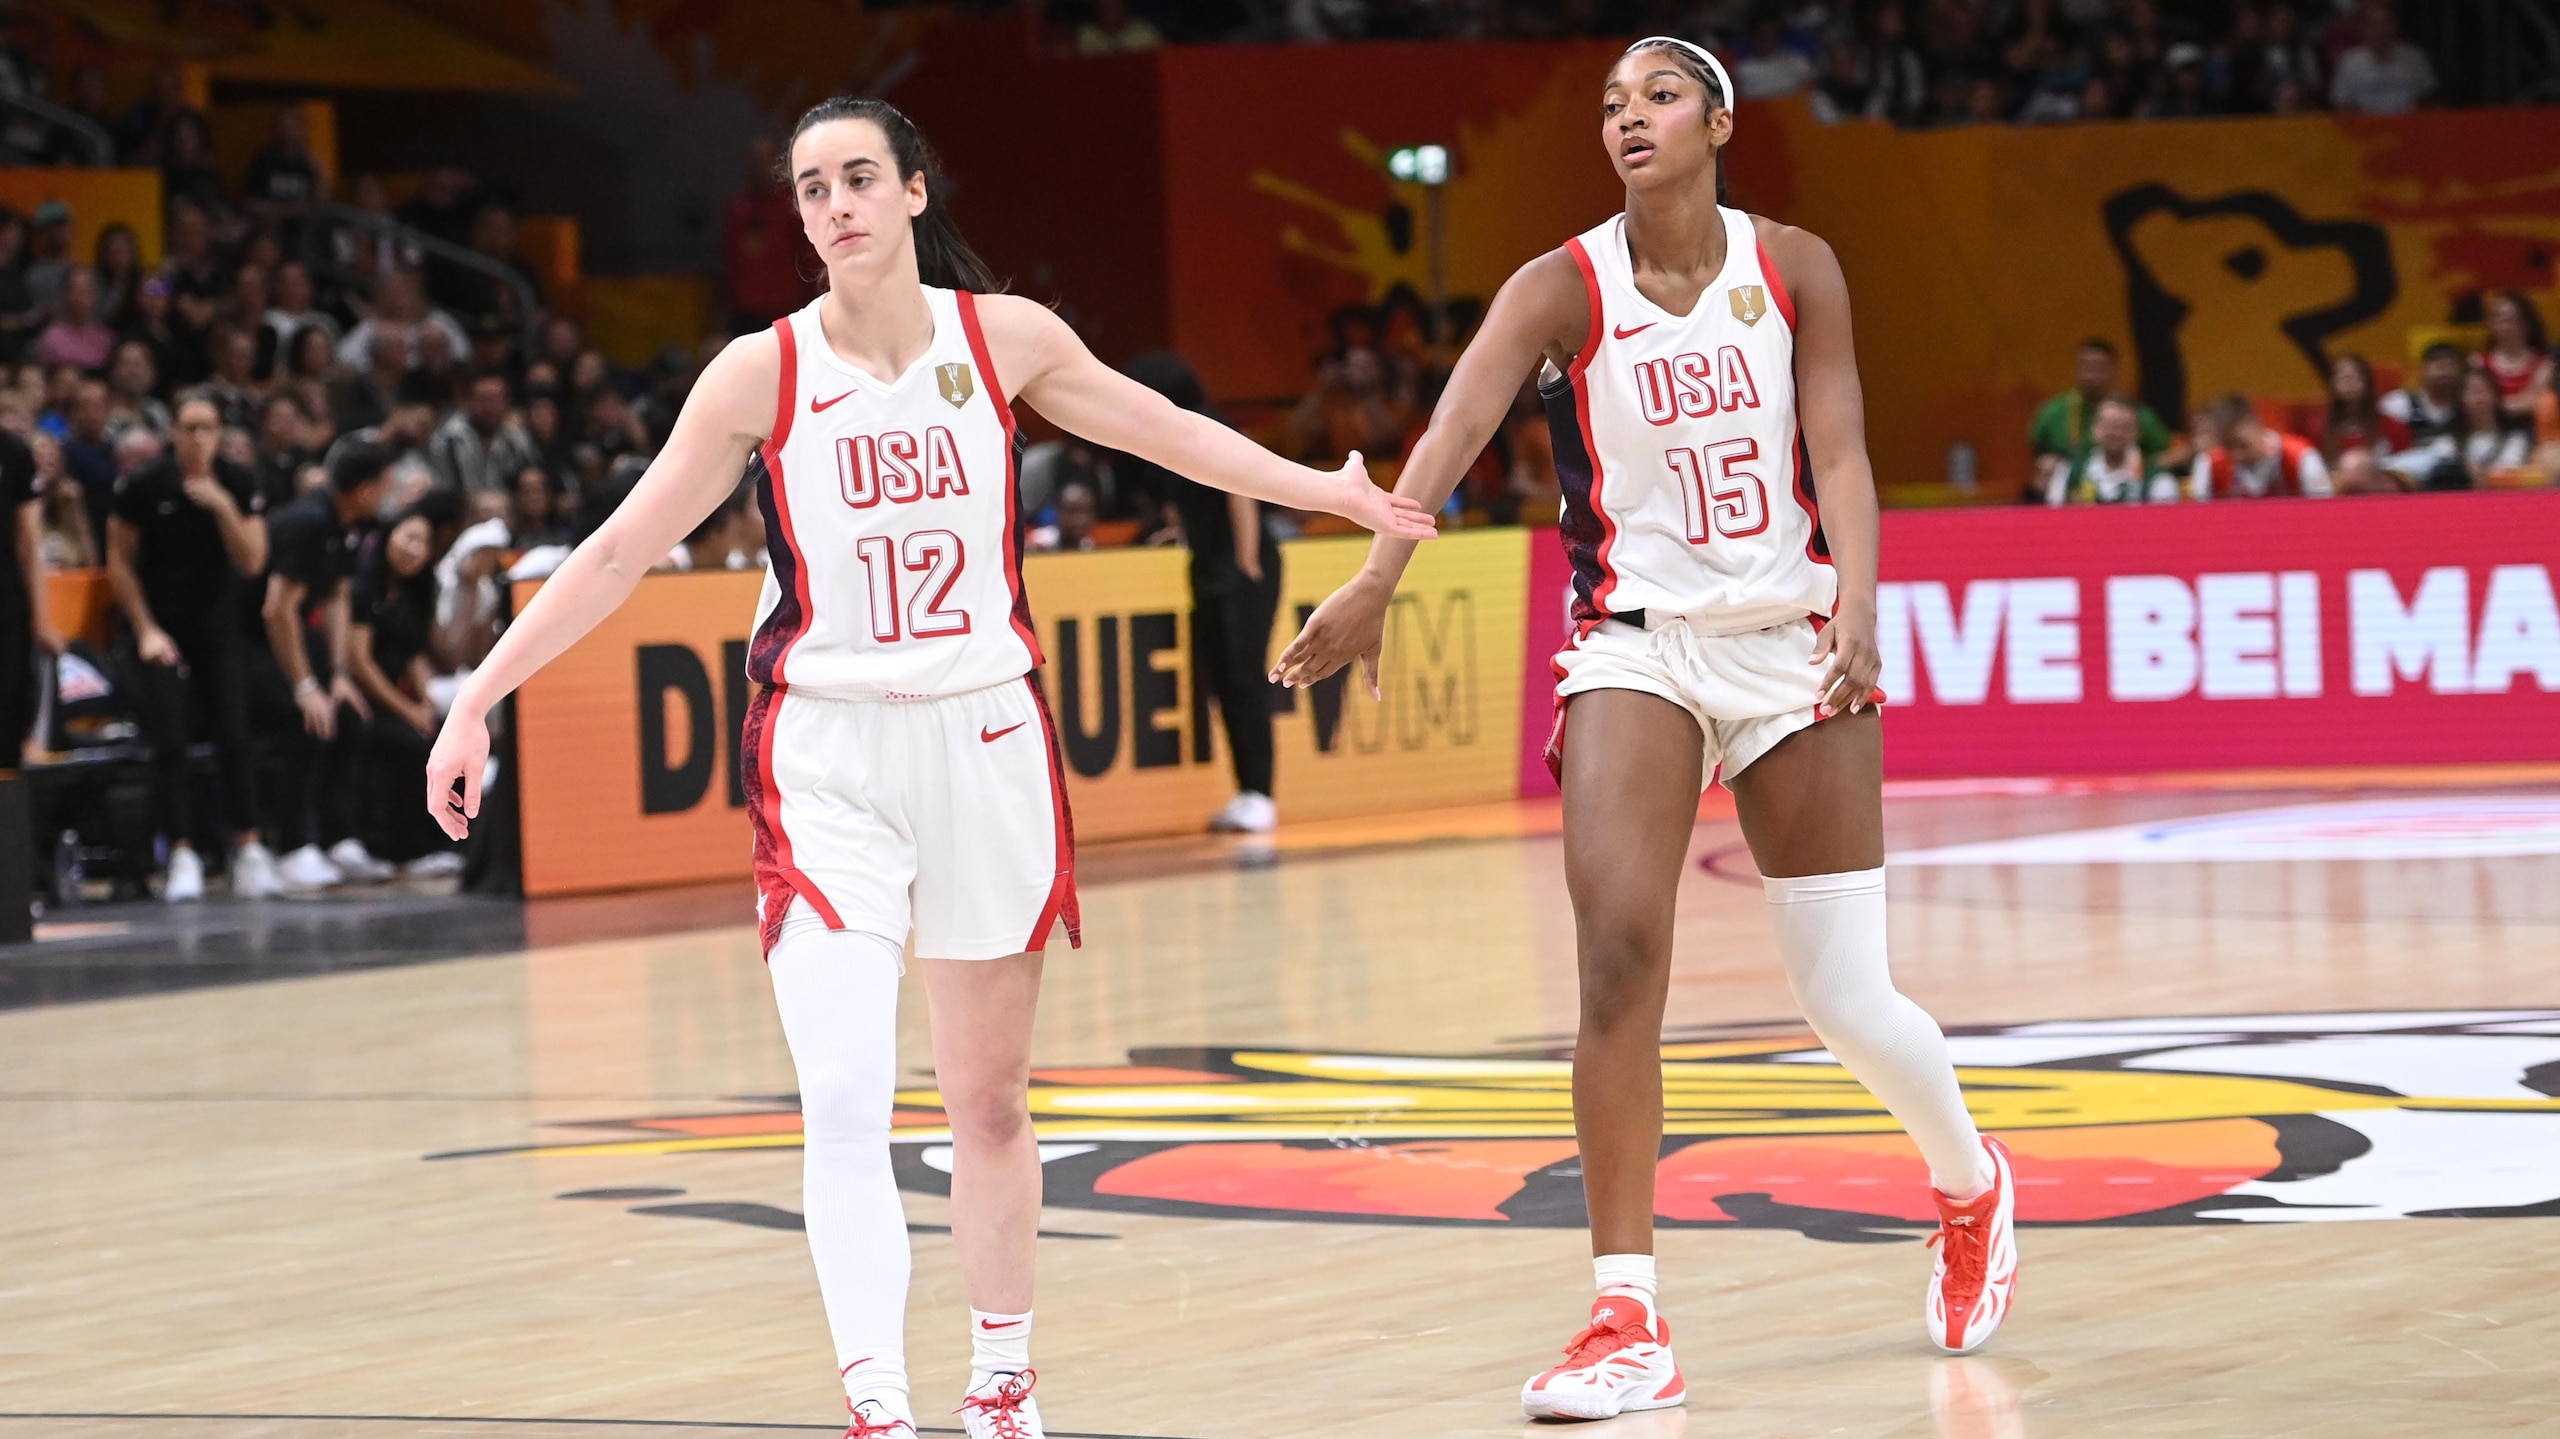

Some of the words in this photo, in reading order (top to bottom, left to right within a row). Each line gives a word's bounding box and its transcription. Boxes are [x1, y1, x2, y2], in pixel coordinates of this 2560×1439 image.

[1634, 345, 1760, 427] USA
[836, 426, 970, 509] USA
[1666, 437, 1769, 544] 15
[857, 529, 971, 643] 12
[1876, 576, 2084, 706] IVE
[2106, 570, 2323, 702] BEI
[2347, 563, 2560, 696] MA
[635, 638, 750, 814] DI
